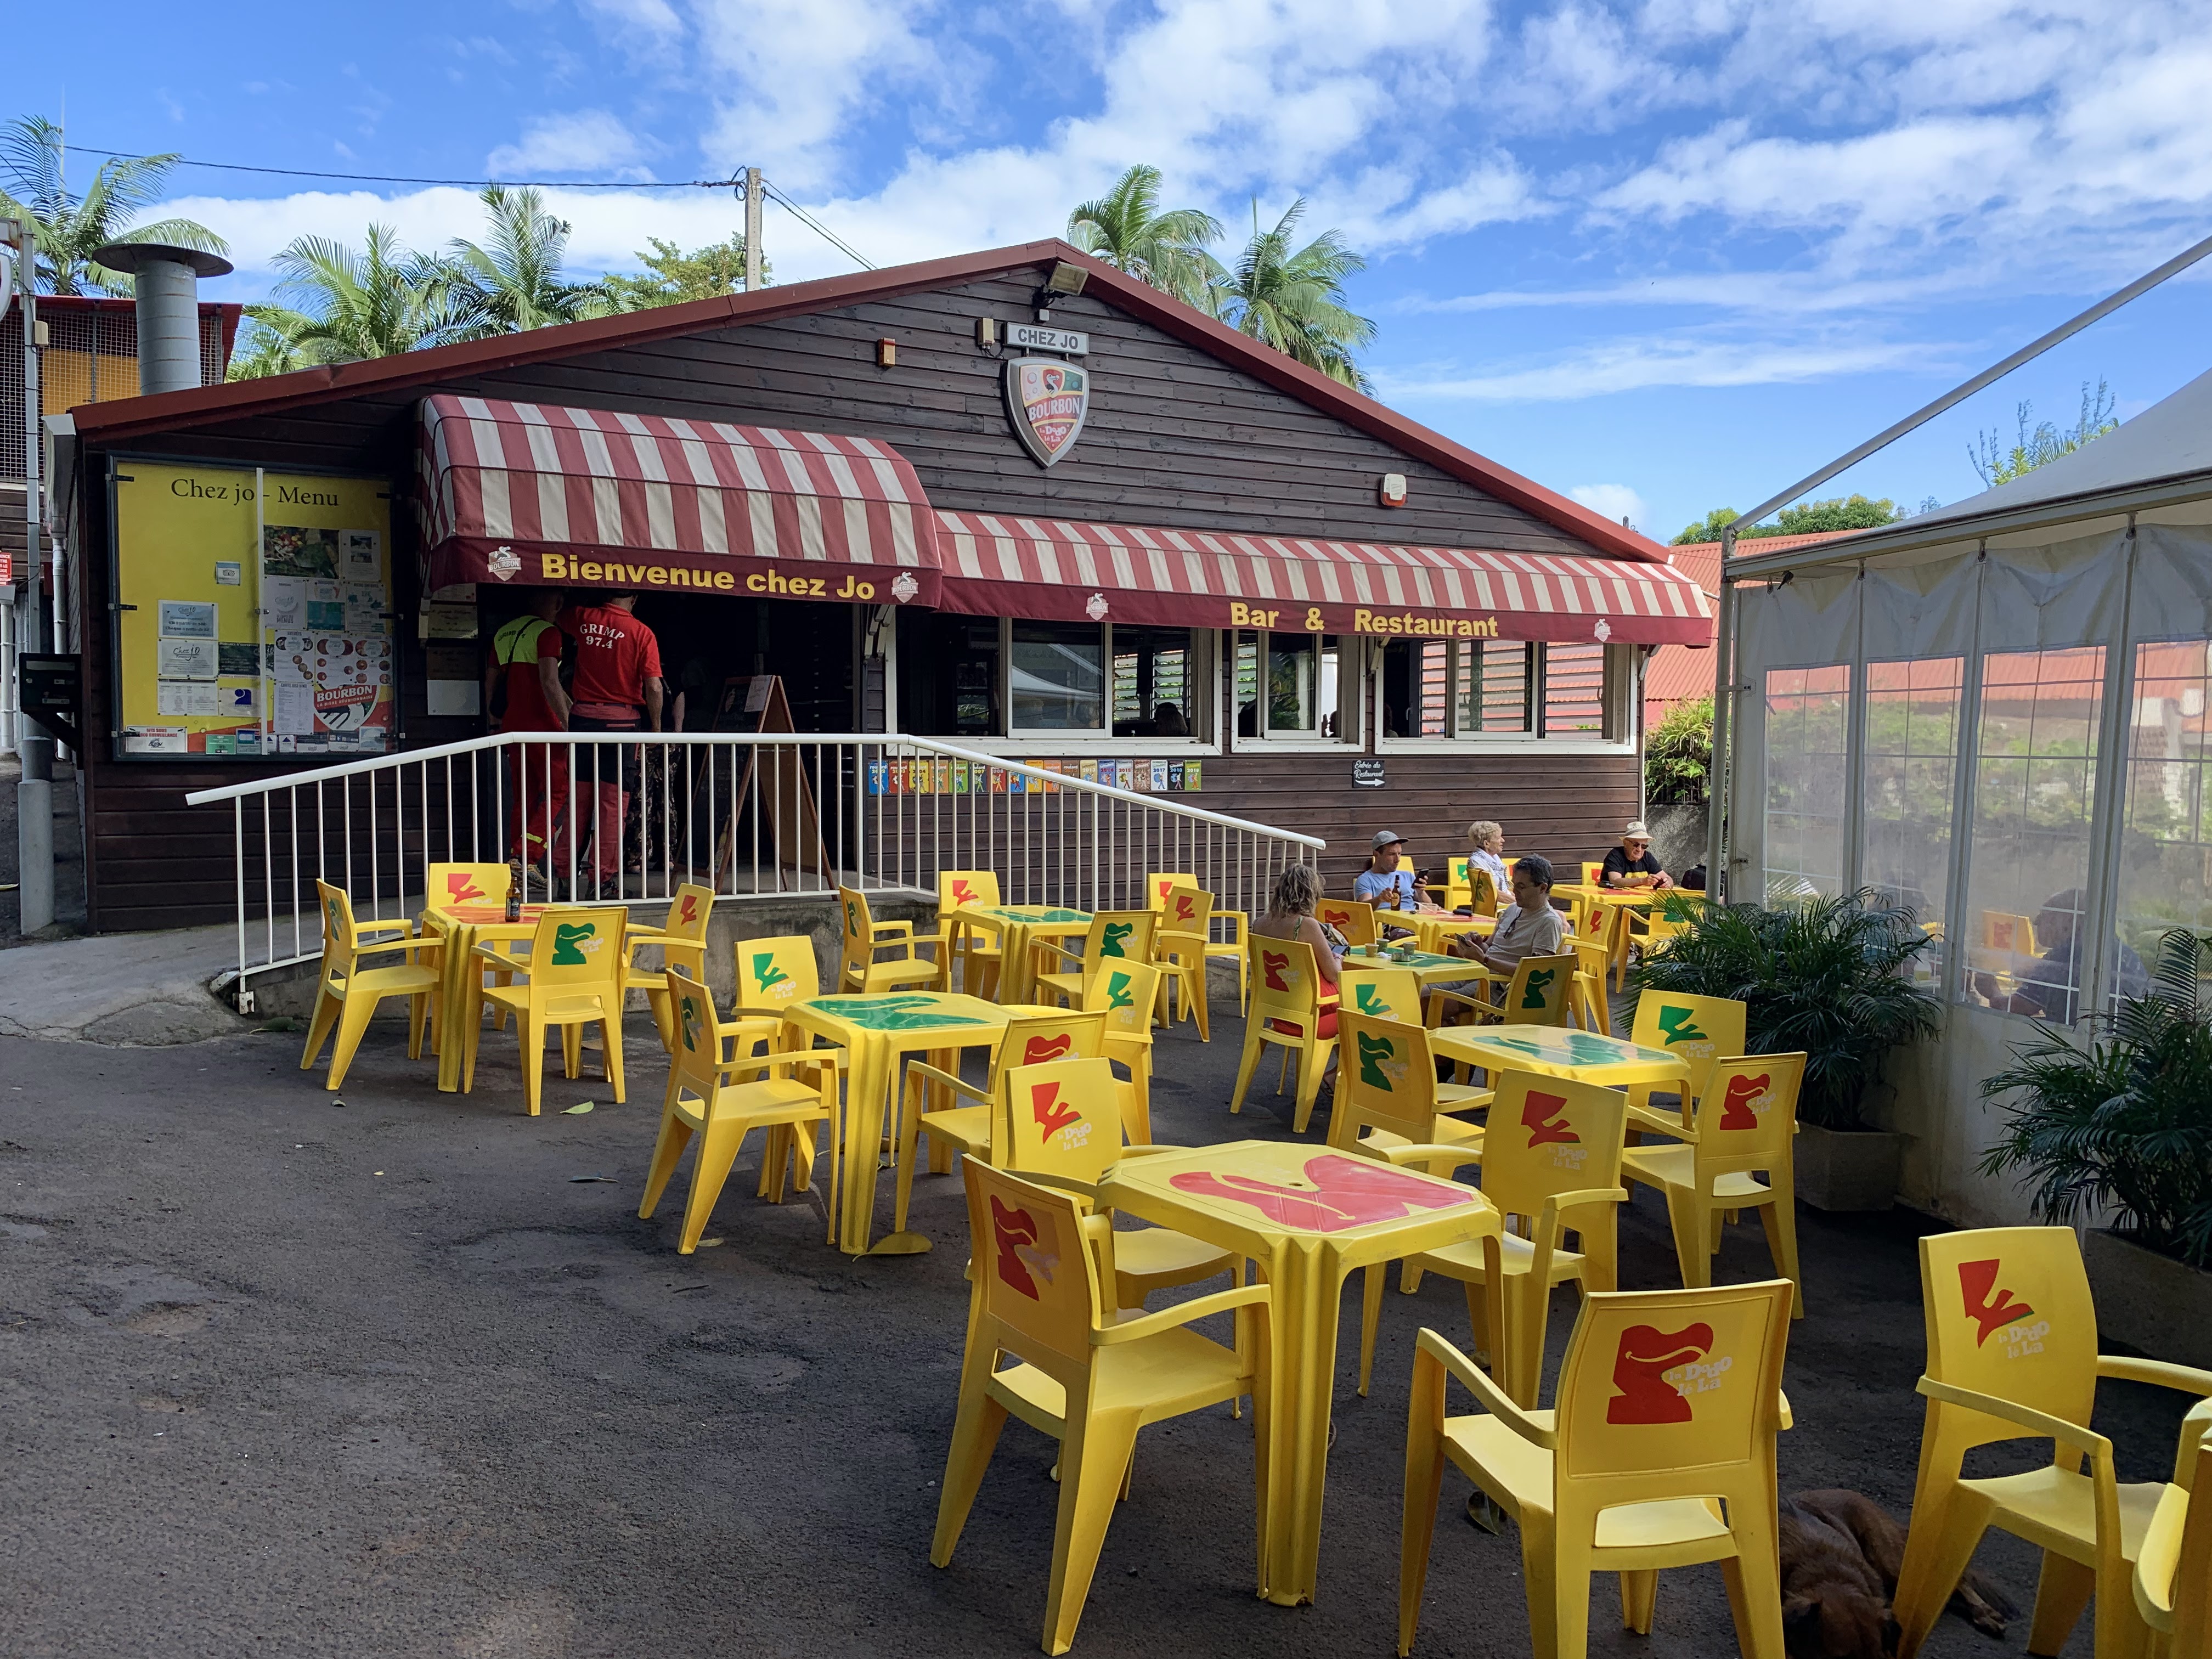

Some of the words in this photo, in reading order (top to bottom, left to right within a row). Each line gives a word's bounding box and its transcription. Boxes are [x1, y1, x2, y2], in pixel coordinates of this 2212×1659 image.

[1018, 329, 1056, 346] CHEZ
[1060, 335, 1078, 349] JO
[1029, 397, 1080, 421] BOURBON
[1046, 426, 1066, 436] Dodo
[171, 478, 228, 499] Chez
[234, 483, 255, 506] jo
[278, 486, 339, 506] Menu
[489, 560, 520, 571] BOURBON
[541, 553, 735, 589] Bienvenue
[747, 569, 826, 596] chez
[837, 575, 875, 600] Jo
[893, 584, 917, 592] BOURBON
[1230, 602, 1279, 628] Bar
[1305, 607, 1325, 631] &
[1354, 609, 1499, 637] Restaurant
[580, 624, 625, 640] GRIMP
[586, 635, 613, 649] 97.4
[317, 686, 373, 702] BOURBON
[1064, 1122, 1092, 1140] Dodo
[1072, 1138, 1088, 1148] La
[2008, 1321, 2050, 1344] Dodo
[2022, 1341, 2044, 1356] La
[1685, 1357, 1733, 1381] Dodo
[1697, 1378, 1721, 1393] La
